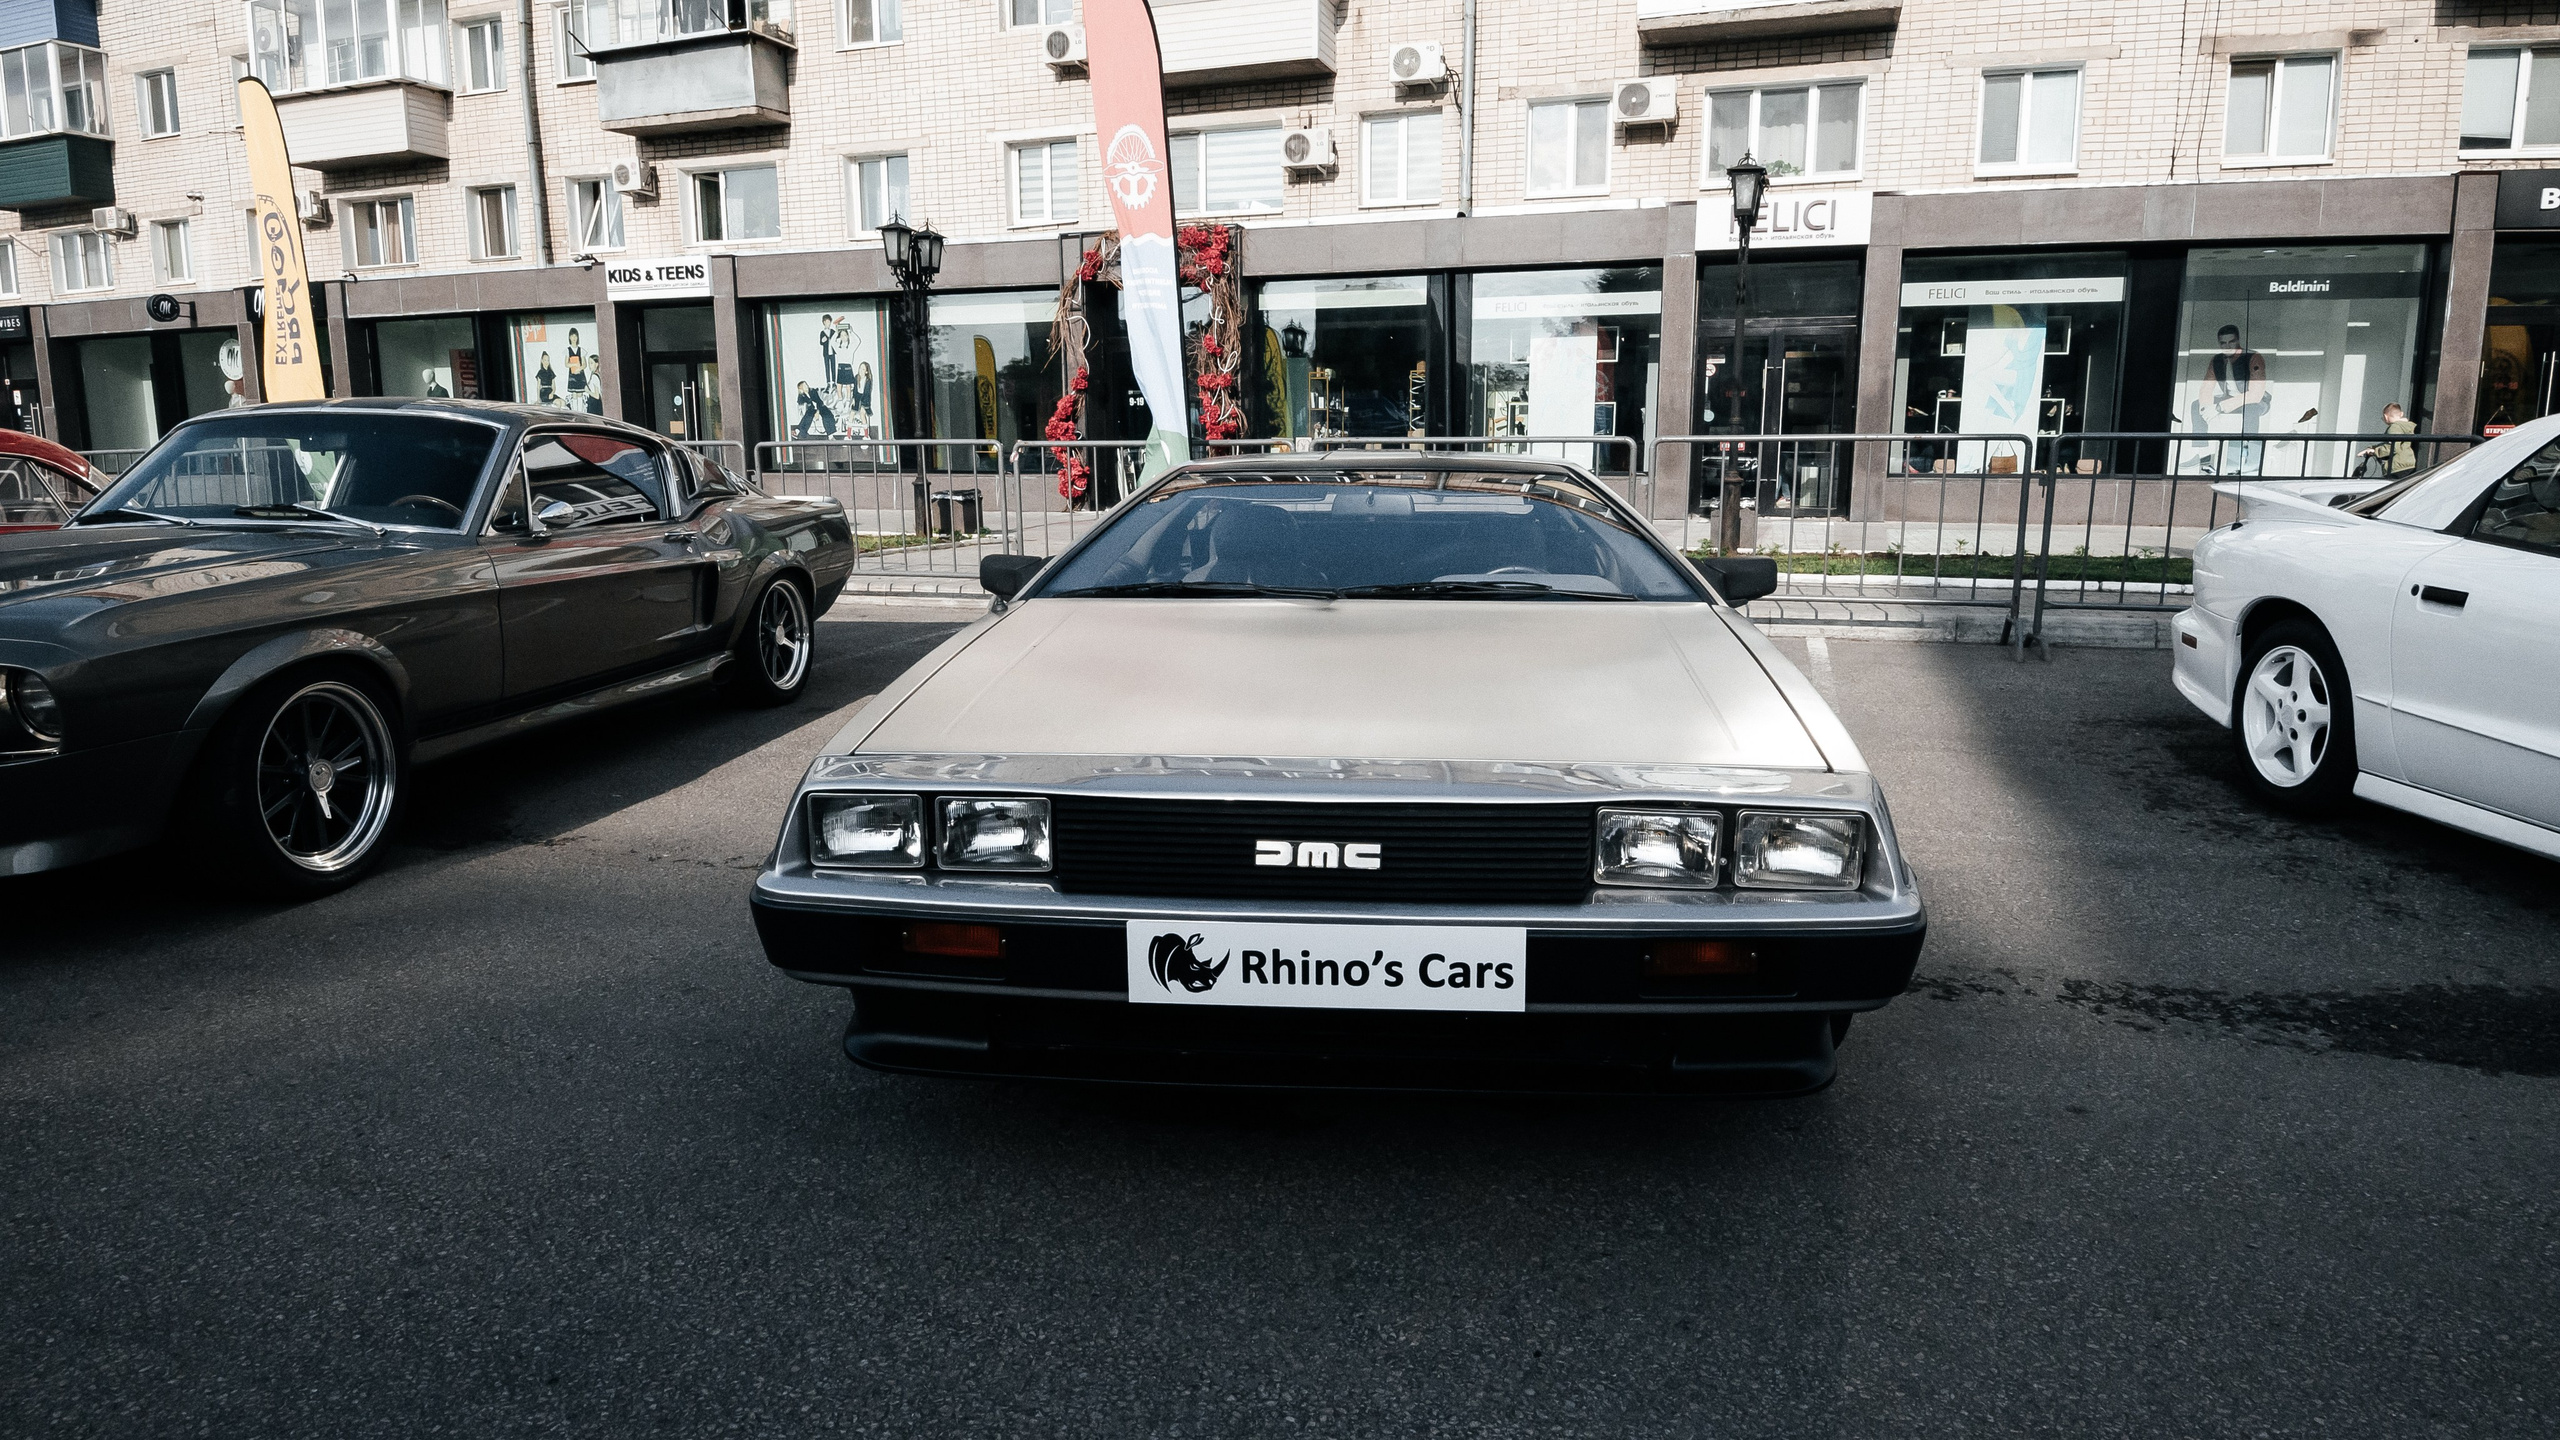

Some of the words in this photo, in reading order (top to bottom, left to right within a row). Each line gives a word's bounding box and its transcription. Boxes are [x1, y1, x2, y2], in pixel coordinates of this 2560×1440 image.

[608, 268, 641, 283] KIDS
[645, 270, 653, 281] &
[656, 264, 704, 280] TEENS
[1928, 288, 1966, 299] FELICI
[2269, 280, 2330, 292] Baldinini
[1495, 302, 1527, 313] FELICI
[1255, 840, 1381, 869] DMC
[1241, 948, 1404, 987] Rhino's
[1418, 953, 1514, 990] Cars
